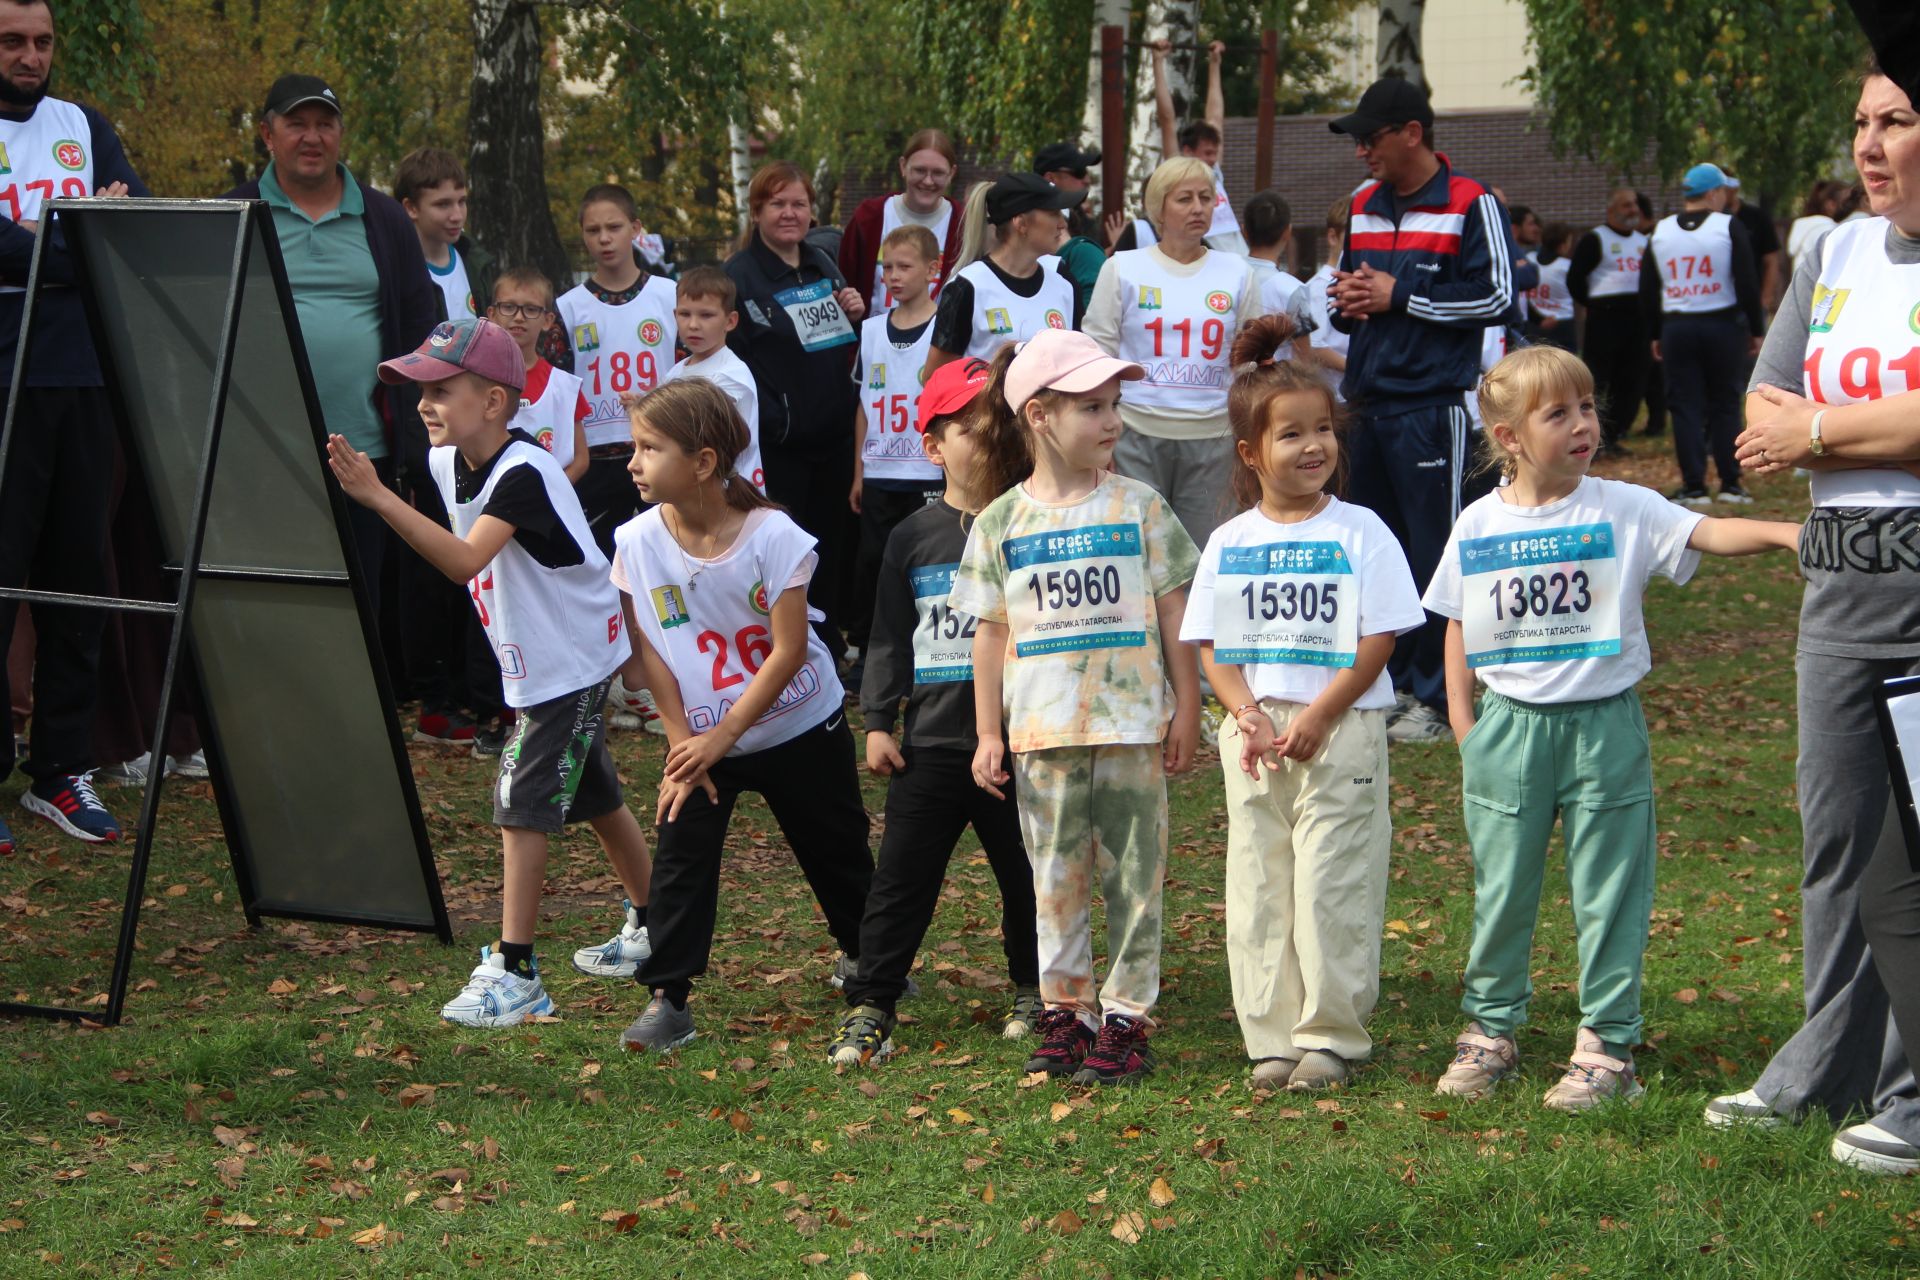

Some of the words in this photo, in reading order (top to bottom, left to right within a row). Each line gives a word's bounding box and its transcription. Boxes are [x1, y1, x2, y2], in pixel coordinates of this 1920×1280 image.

[1666, 254, 1714, 280] 174
[798, 301, 839, 329] 13949
[1144, 316, 1225, 360] 119
[587, 350, 658, 396] 189
[1048, 533, 1092, 551] КРОСС
[1511, 536, 1558, 555] КРОСС
[1270, 548, 1314, 562] КРОСС
[1511, 550, 1560, 561] НАЦИИ
[1269, 561, 1314, 569] НАЦИИ
[1028, 565, 1121, 611] 15960
[1489, 570, 1592, 621] 13823
[1241, 581, 1338, 624] 15305
[1034, 619, 1080, 632] РЕСПУБЛИКА
[1081, 616, 1123, 626] ТАТАРСТАН
[1493, 628, 1544, 641] РЕСПУБЛИКА
[1544, 624, 1592, 636] ТАТАРСТАН
[1242, 633, 1289, 643] РЕСПУБЛИКА
[1289, 634, 1333, 645] ТАТАРСТАН
[930, 652, 972, 662] РЕСПУБЛИКА
